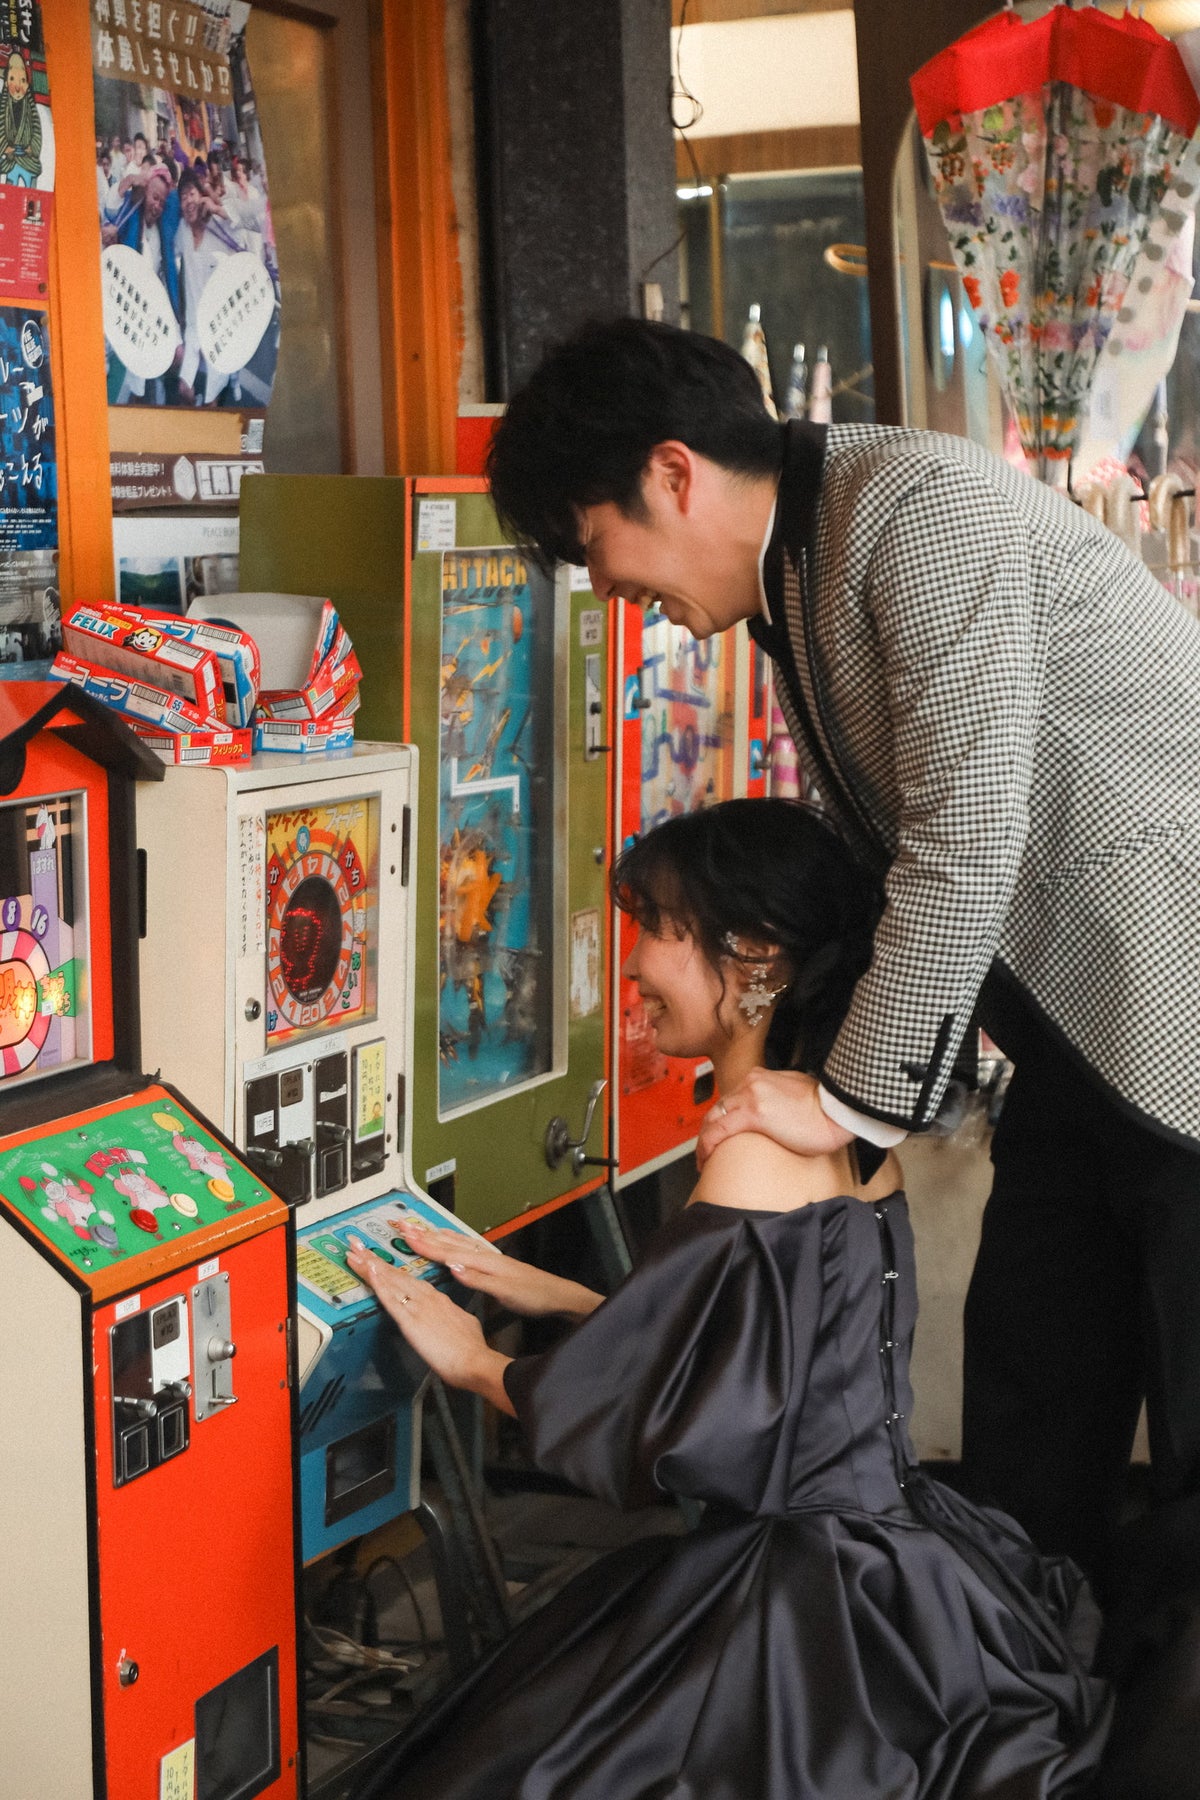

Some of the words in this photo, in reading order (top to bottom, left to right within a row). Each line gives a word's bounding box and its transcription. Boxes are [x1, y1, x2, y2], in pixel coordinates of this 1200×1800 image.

[443, 555, 527, 590] ATTACK
[70, 612, 119, 640] FELIX
[32, 857, 56, 875] はずれ
[344, 850, 361, 887] かち
[7, 900, 17, 926] 8
[31, 908, 48, 936] 16
[341, 951, 362, 1010] あいこ
[301, 1003, 321, 1026] 20
